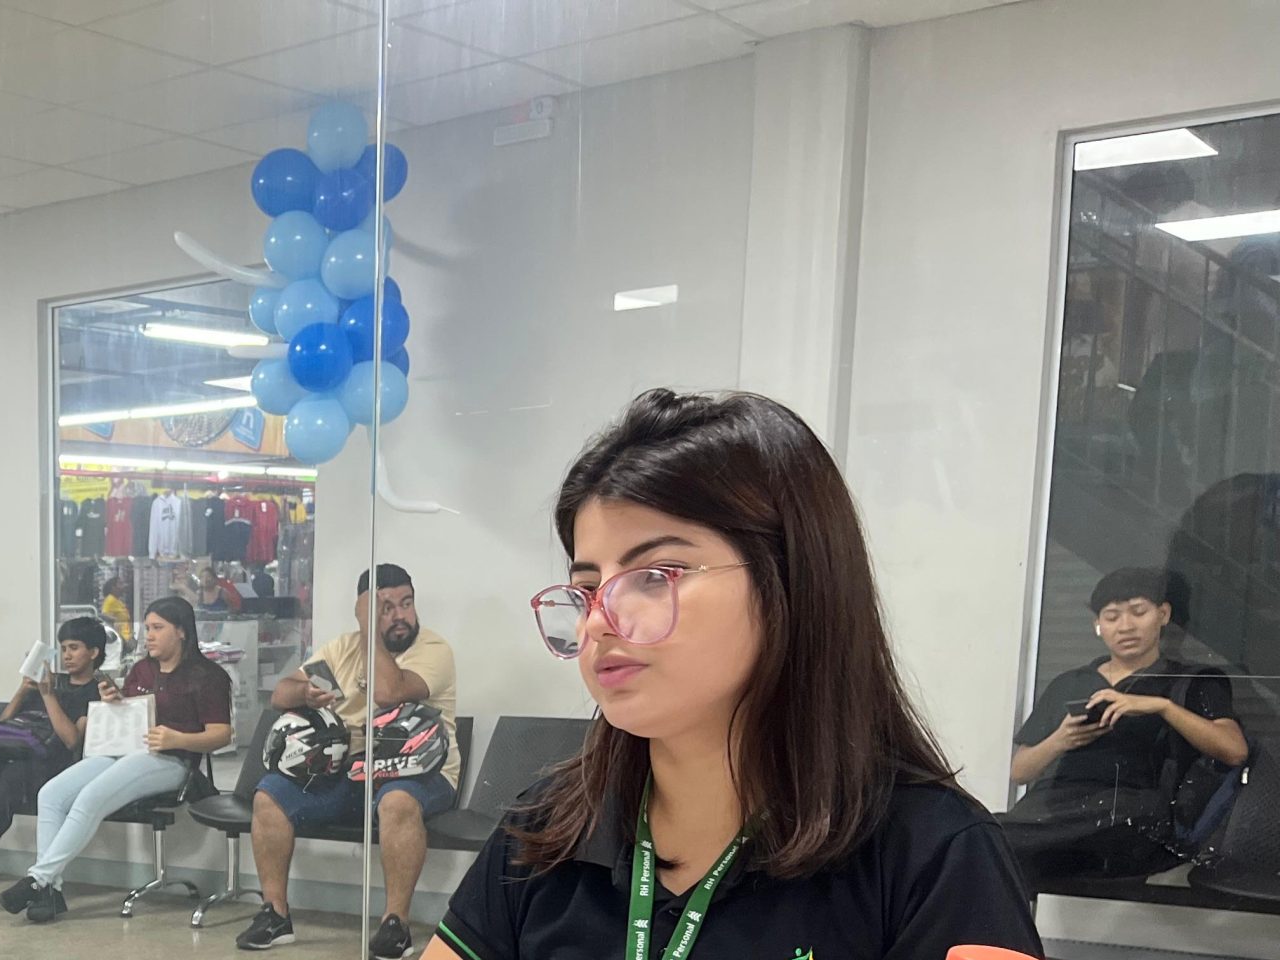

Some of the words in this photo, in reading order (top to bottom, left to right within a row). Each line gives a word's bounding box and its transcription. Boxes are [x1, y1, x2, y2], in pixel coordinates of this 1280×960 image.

[641, 851, 651, 882] Personal
[639, 884, 649, 896] RH
[704, 878, 715, 890] RH
[673, 922, 696, 958] Personal
